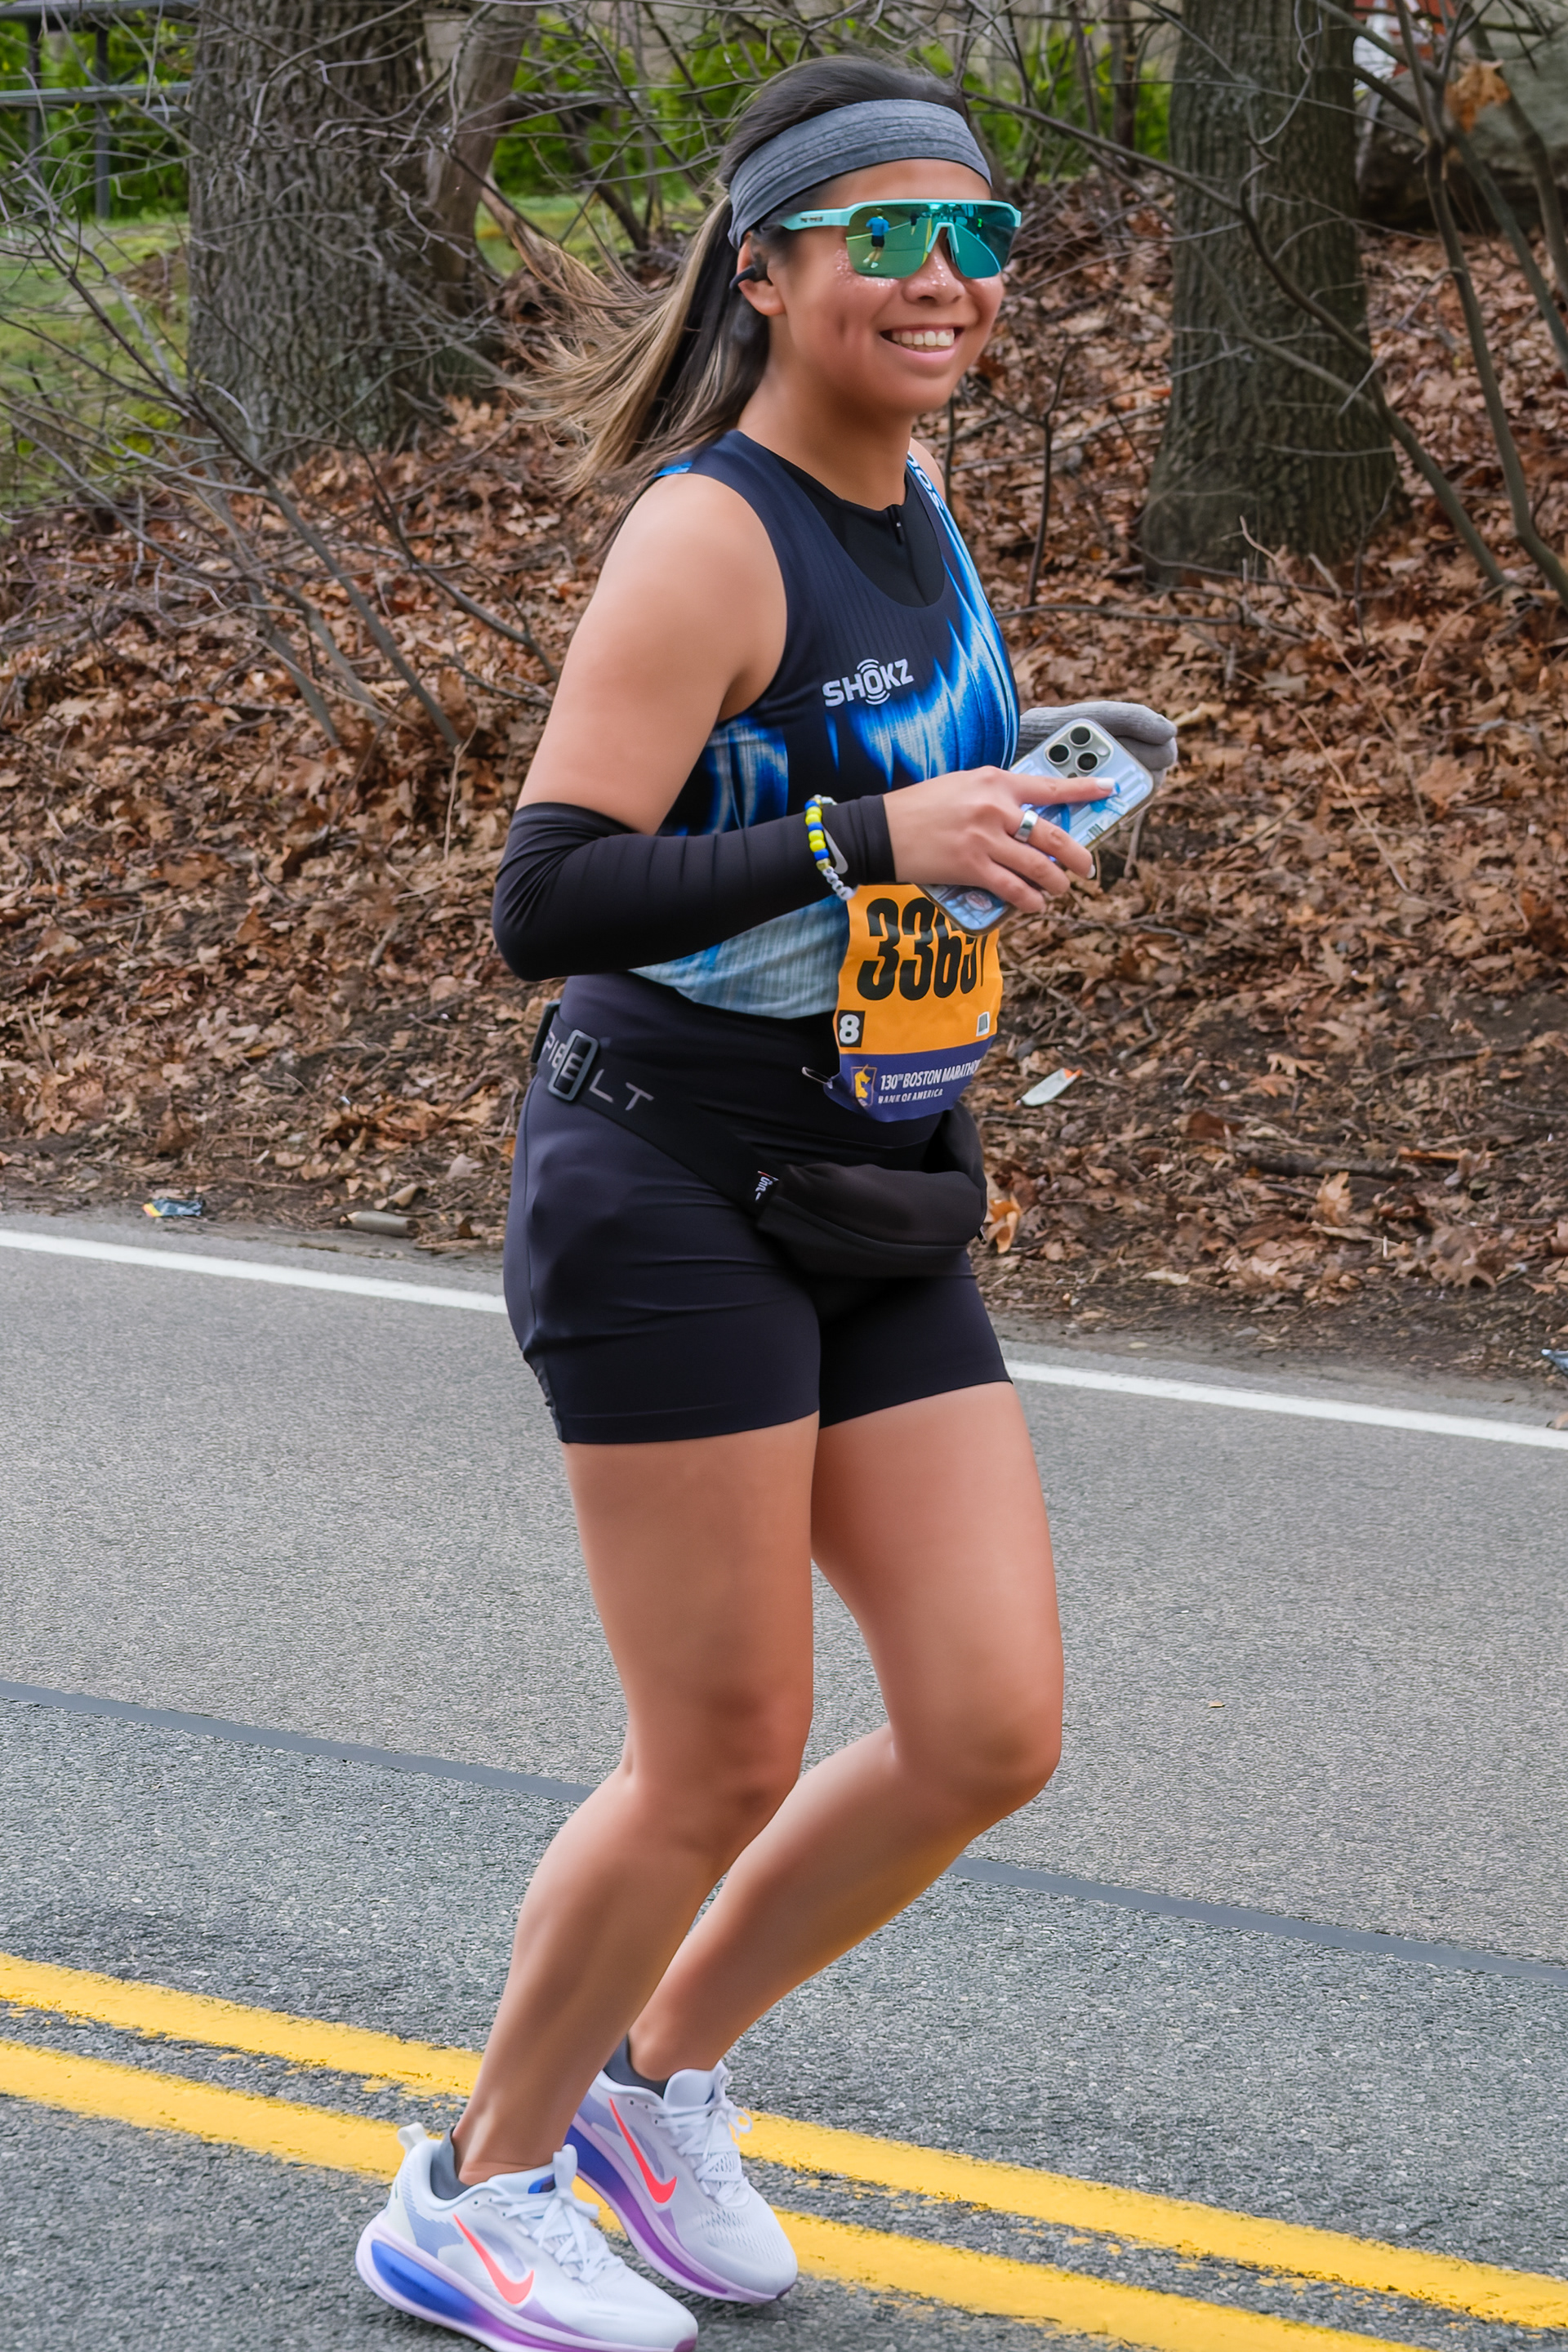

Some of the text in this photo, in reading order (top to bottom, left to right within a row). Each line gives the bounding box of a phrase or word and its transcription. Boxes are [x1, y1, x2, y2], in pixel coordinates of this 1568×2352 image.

[822, 658, 915, 707] SHOKZ
[840, 1013, 860, 1045] 8
[902, 1068, 942, 1089] BOSTON
[901, 1092, 912, 1102] OF
[911, 1088, 944, 1102] AMERICA
